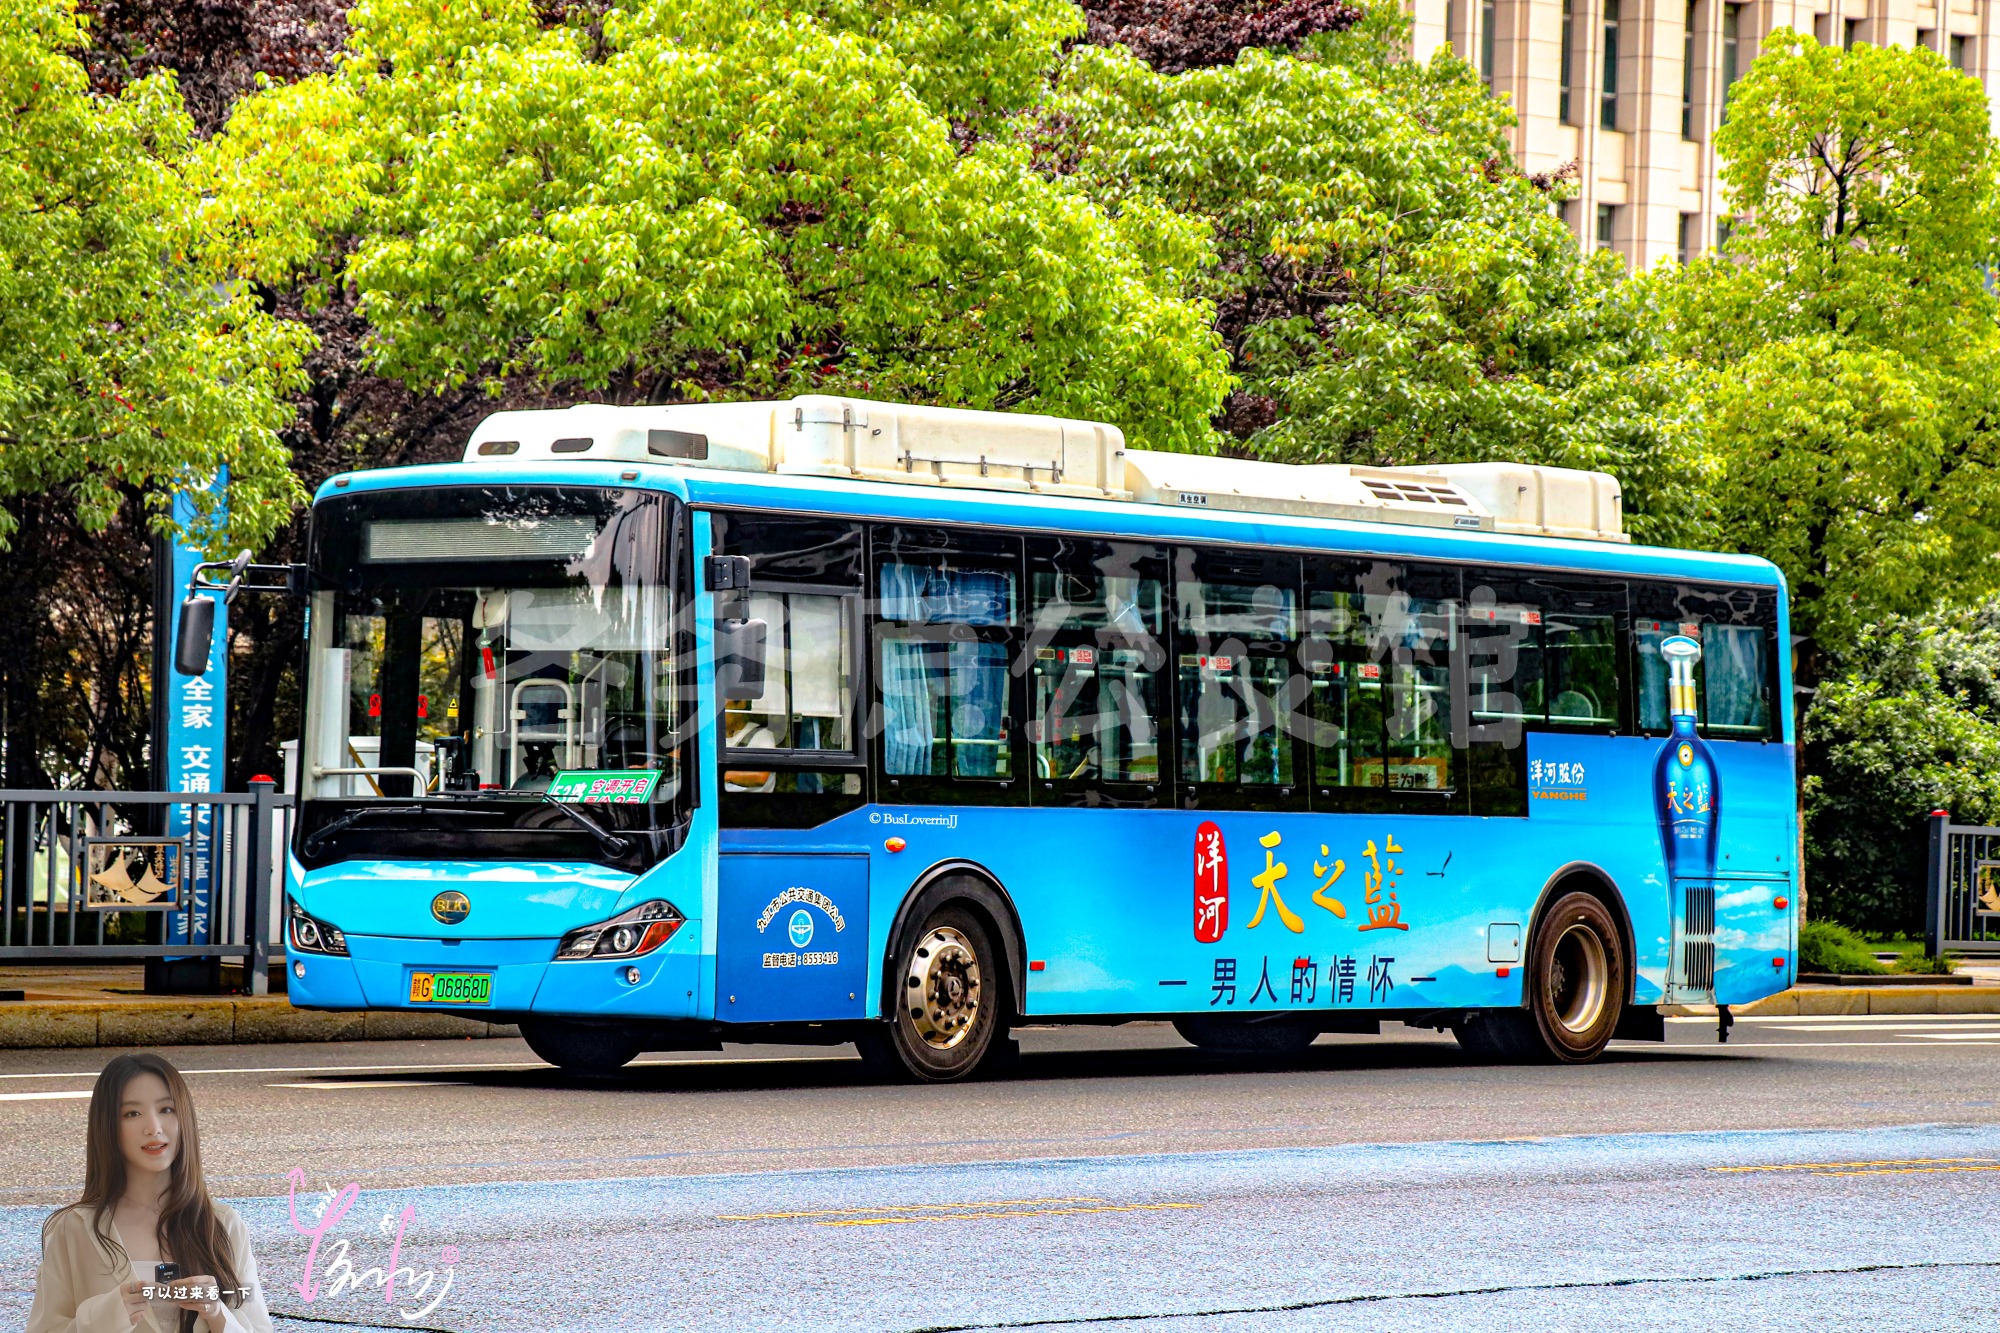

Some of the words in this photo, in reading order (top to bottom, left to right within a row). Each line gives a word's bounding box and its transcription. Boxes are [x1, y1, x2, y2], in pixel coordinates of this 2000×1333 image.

[588, 778, 650, 795] 空调开启
[1530, 759, 1586, 787] 洋河股份
[1531, 790, 1588, 801] YANGHE
[1196, 830, 1227, 939] 洋河
[757, 887, 846, 933] 九江市公共交通集团公司
